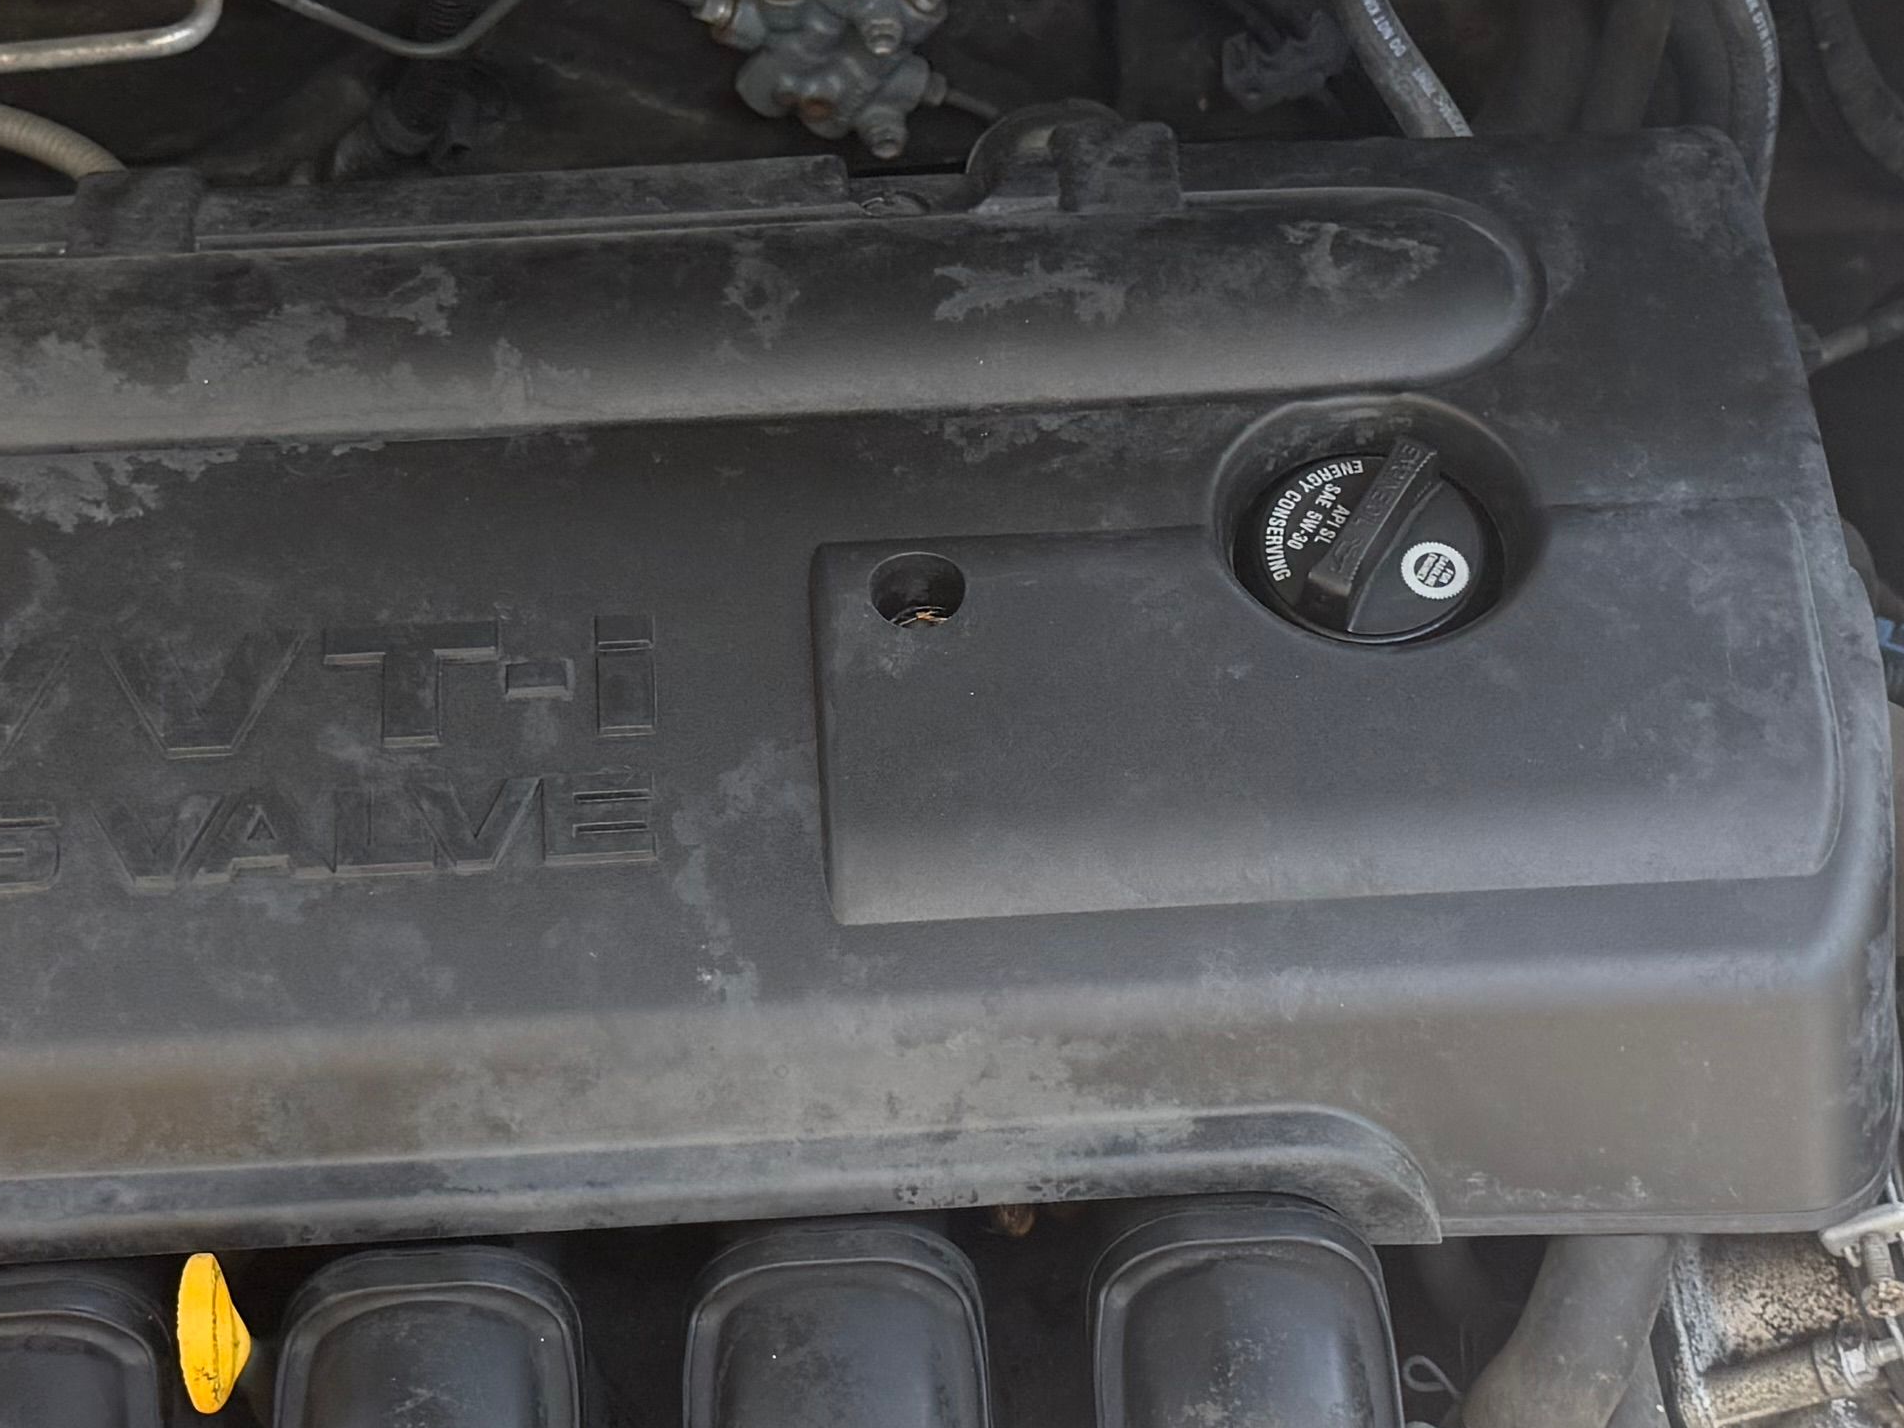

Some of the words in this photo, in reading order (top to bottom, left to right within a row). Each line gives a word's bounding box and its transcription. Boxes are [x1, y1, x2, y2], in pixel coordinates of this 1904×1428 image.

[1301, 458, 1364, 494] ENERGY
[1314, 483, 1343, 509] SAE
[1264, 489, 1302, 583] CONSERVING
[92, 770, 660, 895] VALVE
